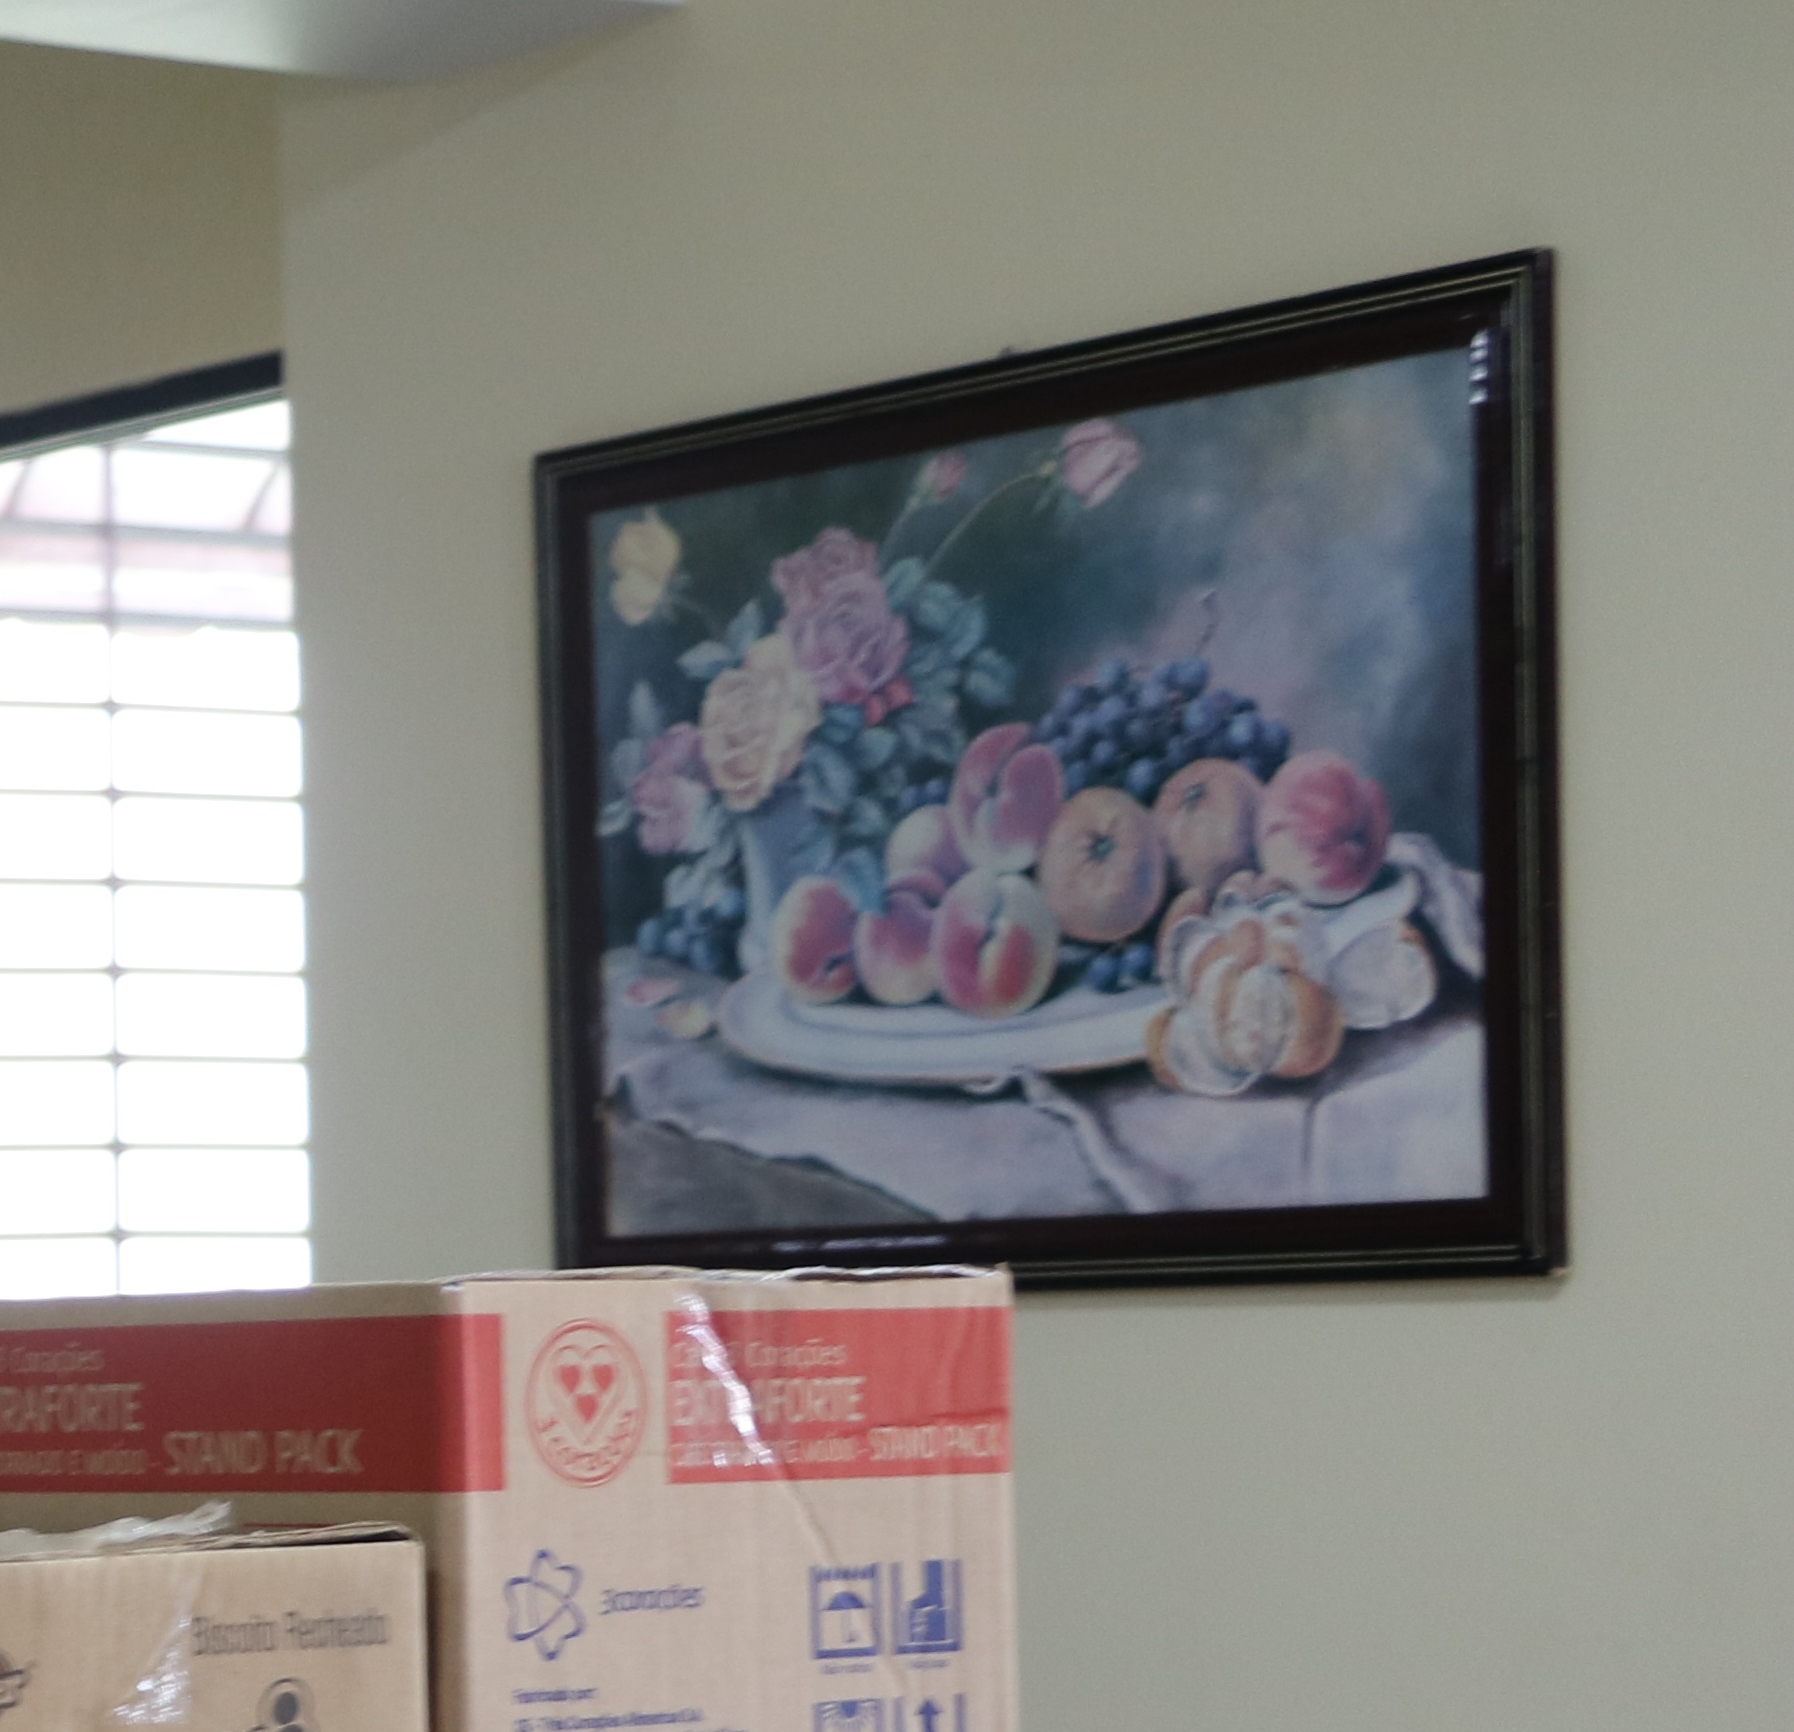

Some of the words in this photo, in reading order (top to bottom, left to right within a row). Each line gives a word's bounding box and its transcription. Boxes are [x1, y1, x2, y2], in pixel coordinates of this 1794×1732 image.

[163, 1429, 267, 1477] STAND
[274, 1429, 364, 1477] PACK
[869, 1424, 936, 1461] STAND
[944, 1423, 1001, 1458] PACK
